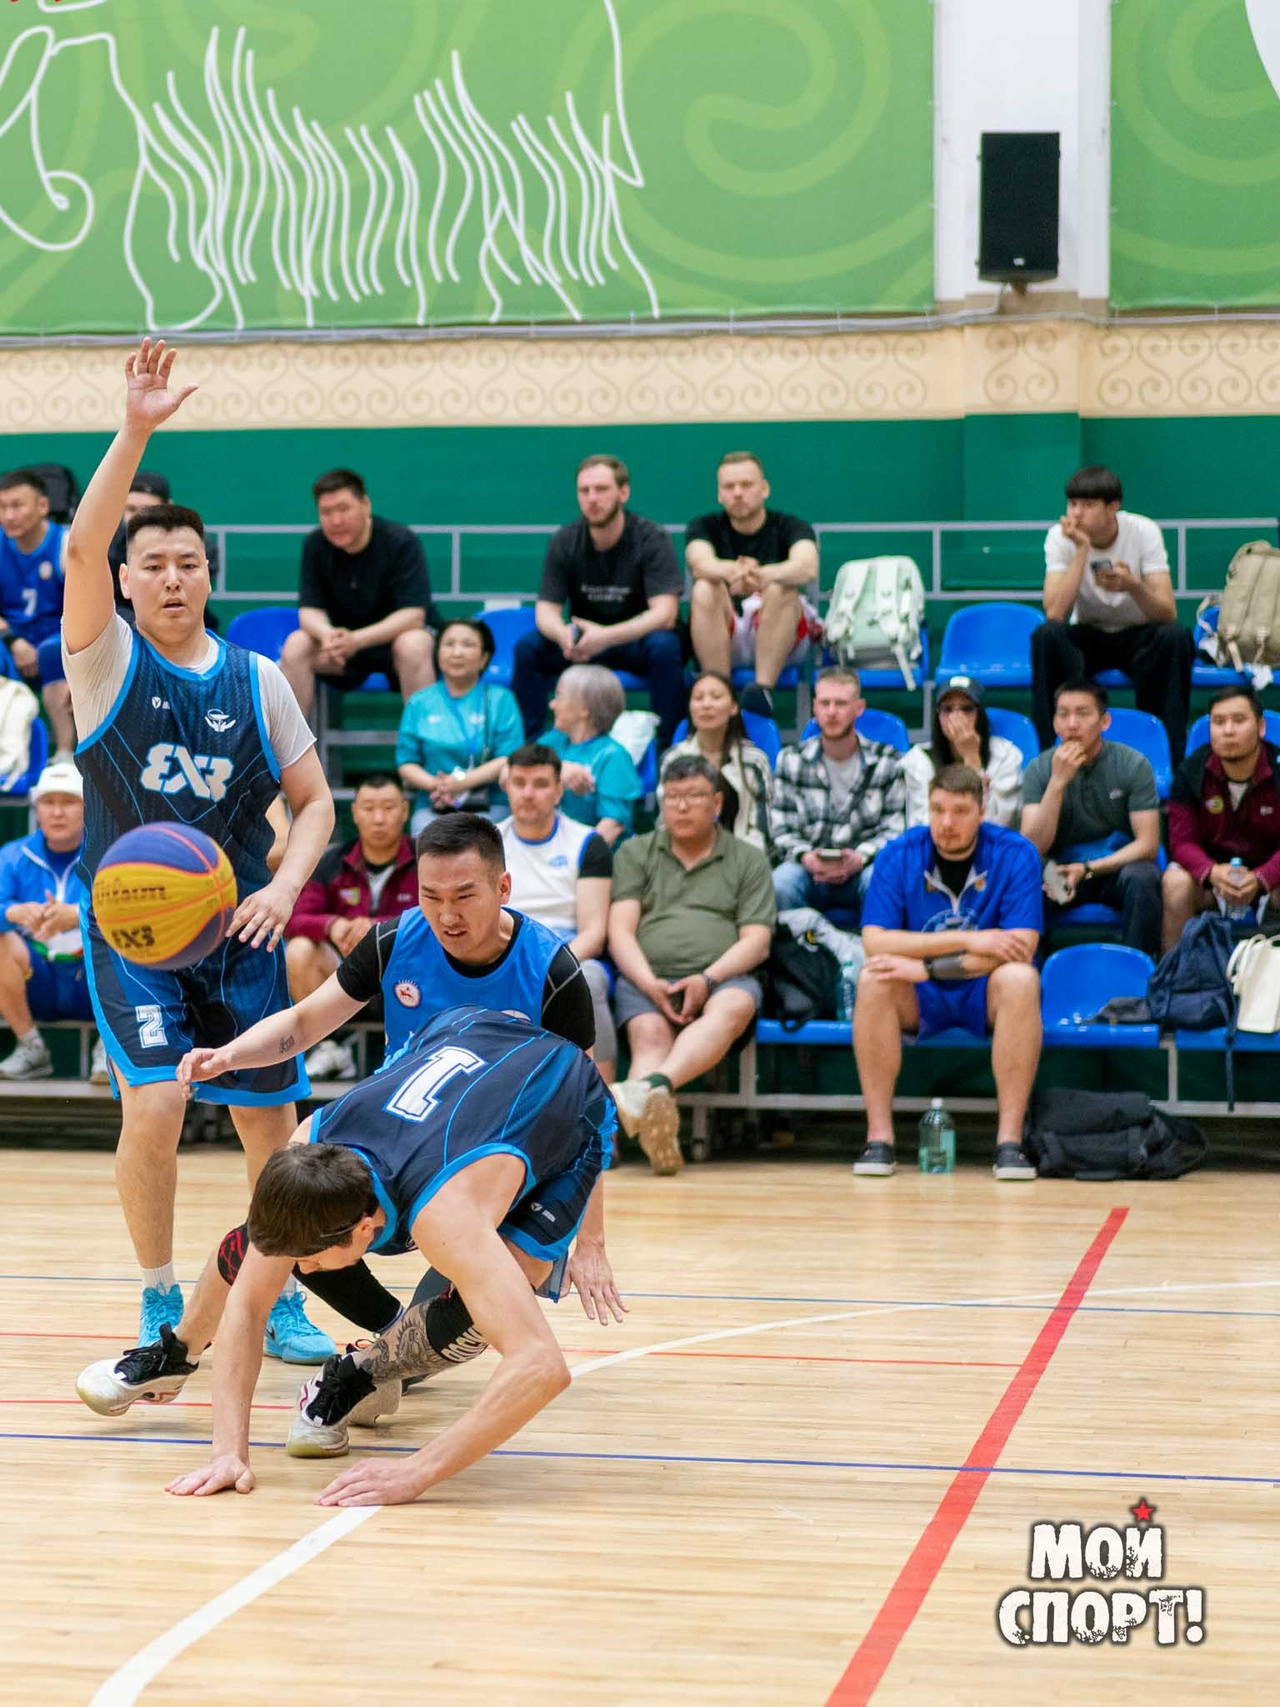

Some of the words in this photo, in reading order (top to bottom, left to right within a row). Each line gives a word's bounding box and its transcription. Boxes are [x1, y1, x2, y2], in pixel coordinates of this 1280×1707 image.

[22, 588, 37, 617] 7
[135, 1004, 168, 1048] 2
[384, 1046, 487, 1121] 1
